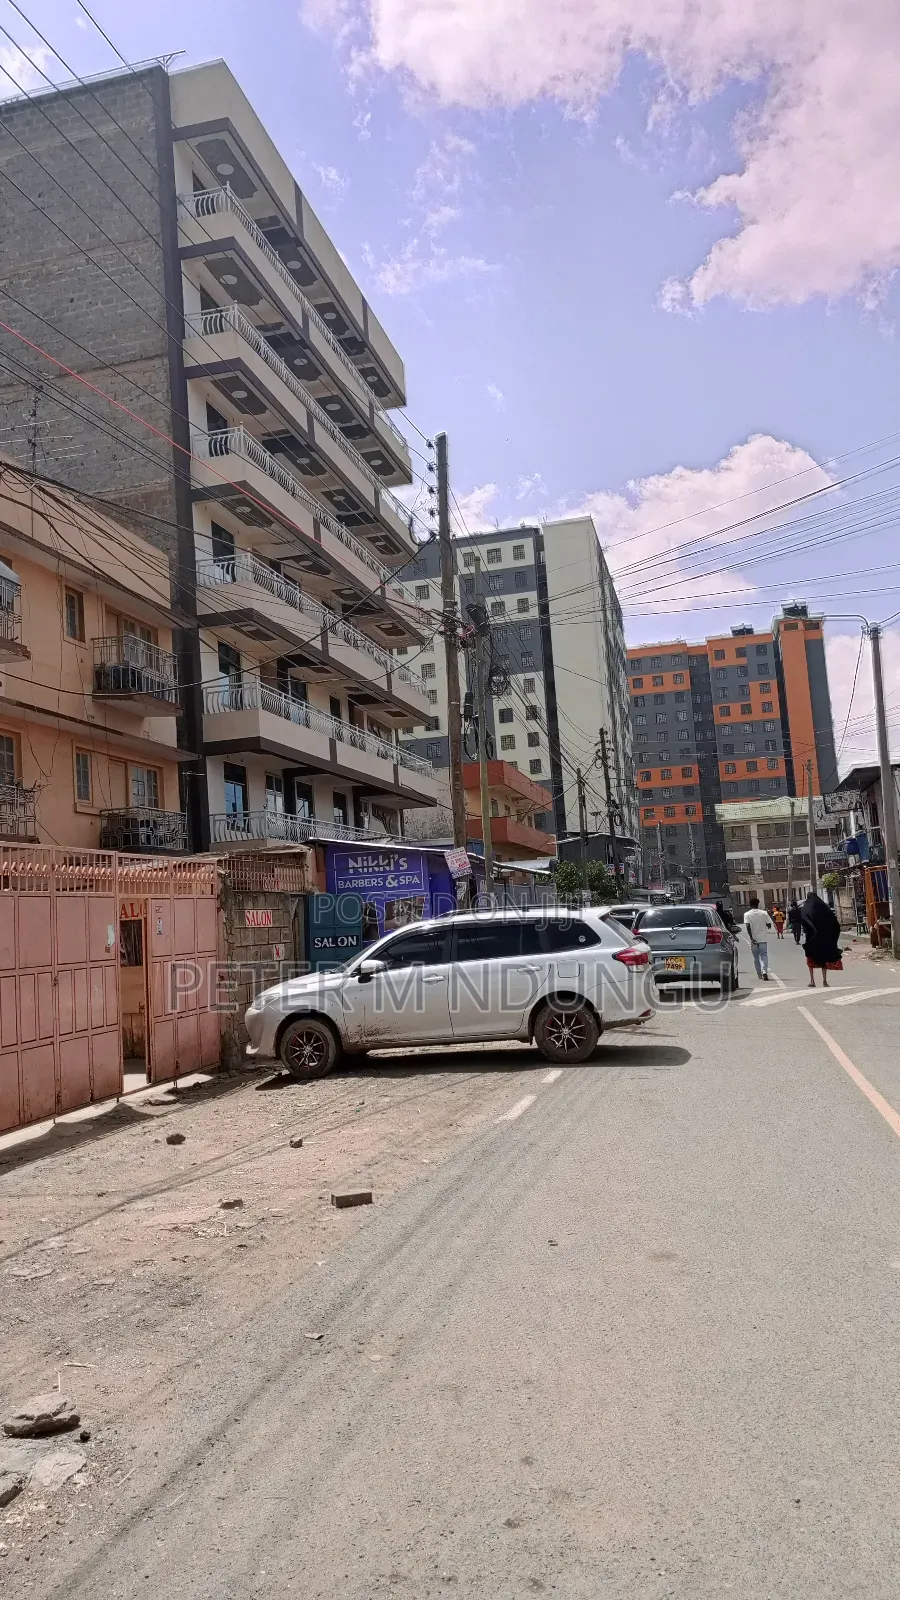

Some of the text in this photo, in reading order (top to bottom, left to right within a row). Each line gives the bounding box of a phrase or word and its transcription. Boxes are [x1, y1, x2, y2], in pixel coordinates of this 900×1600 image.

[348, 854, 408, 874] Nikki's
[337, 874, 421, 889] BARBERS & SPA
[245, 910, 272, 927] SALON
